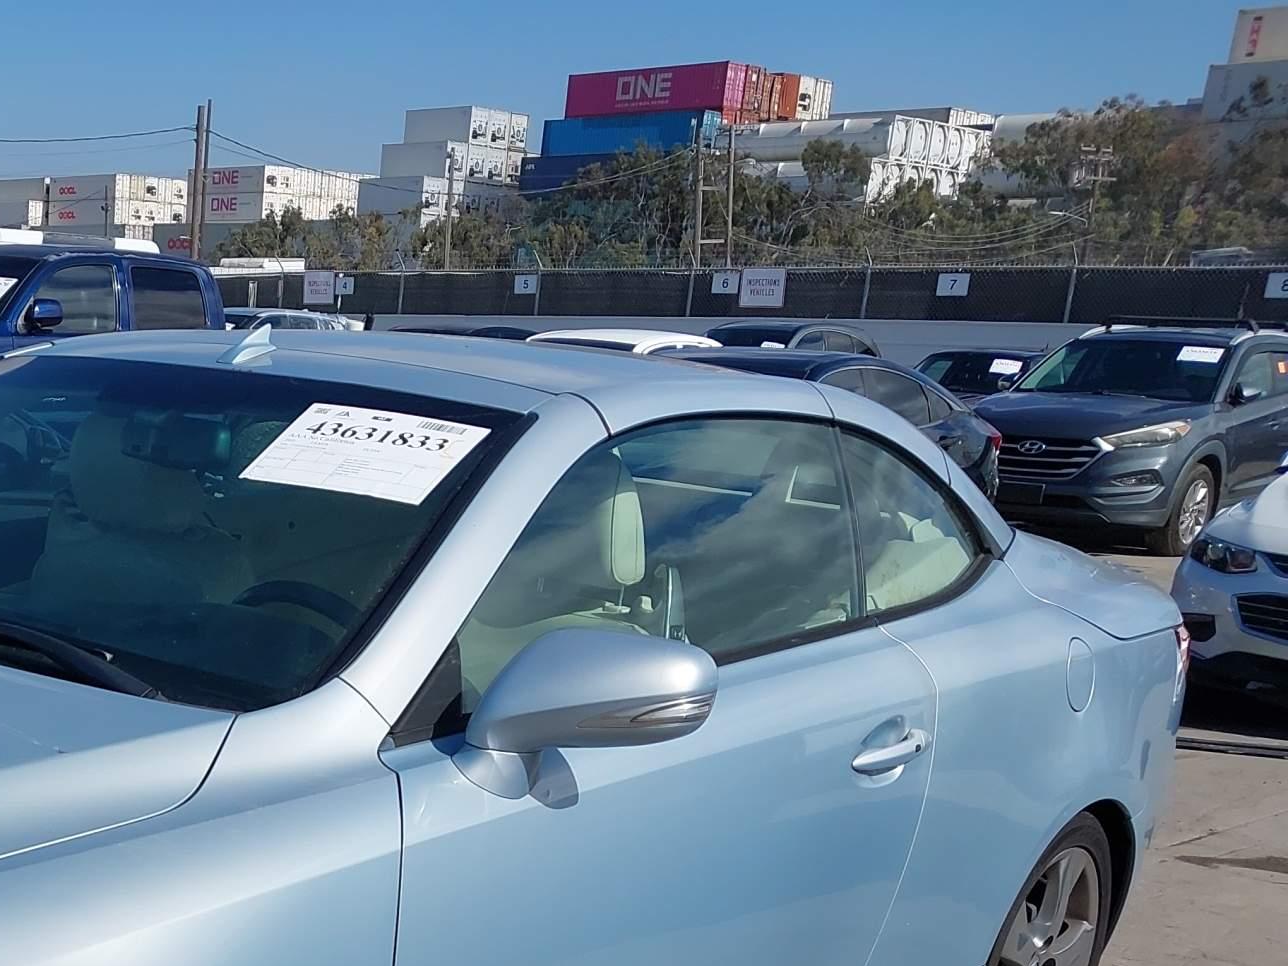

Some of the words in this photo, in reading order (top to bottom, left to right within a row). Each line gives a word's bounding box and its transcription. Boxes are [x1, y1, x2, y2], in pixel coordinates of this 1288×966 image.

[615, 72, 673, 101] ONE
[212, 170, 239, 185] ONE
[58, 186, 77, 195] OOCL
[211, 197, 237, 211] ONE
[167, 238, 193, 250] OOC
[342, 281, 348, 290] 4
[522, 279, 529, 289] 5
[721, 278, 729, 289] 6
[949, 279, 958, 290] 7
[305, 420, 450, 452] 43631833
